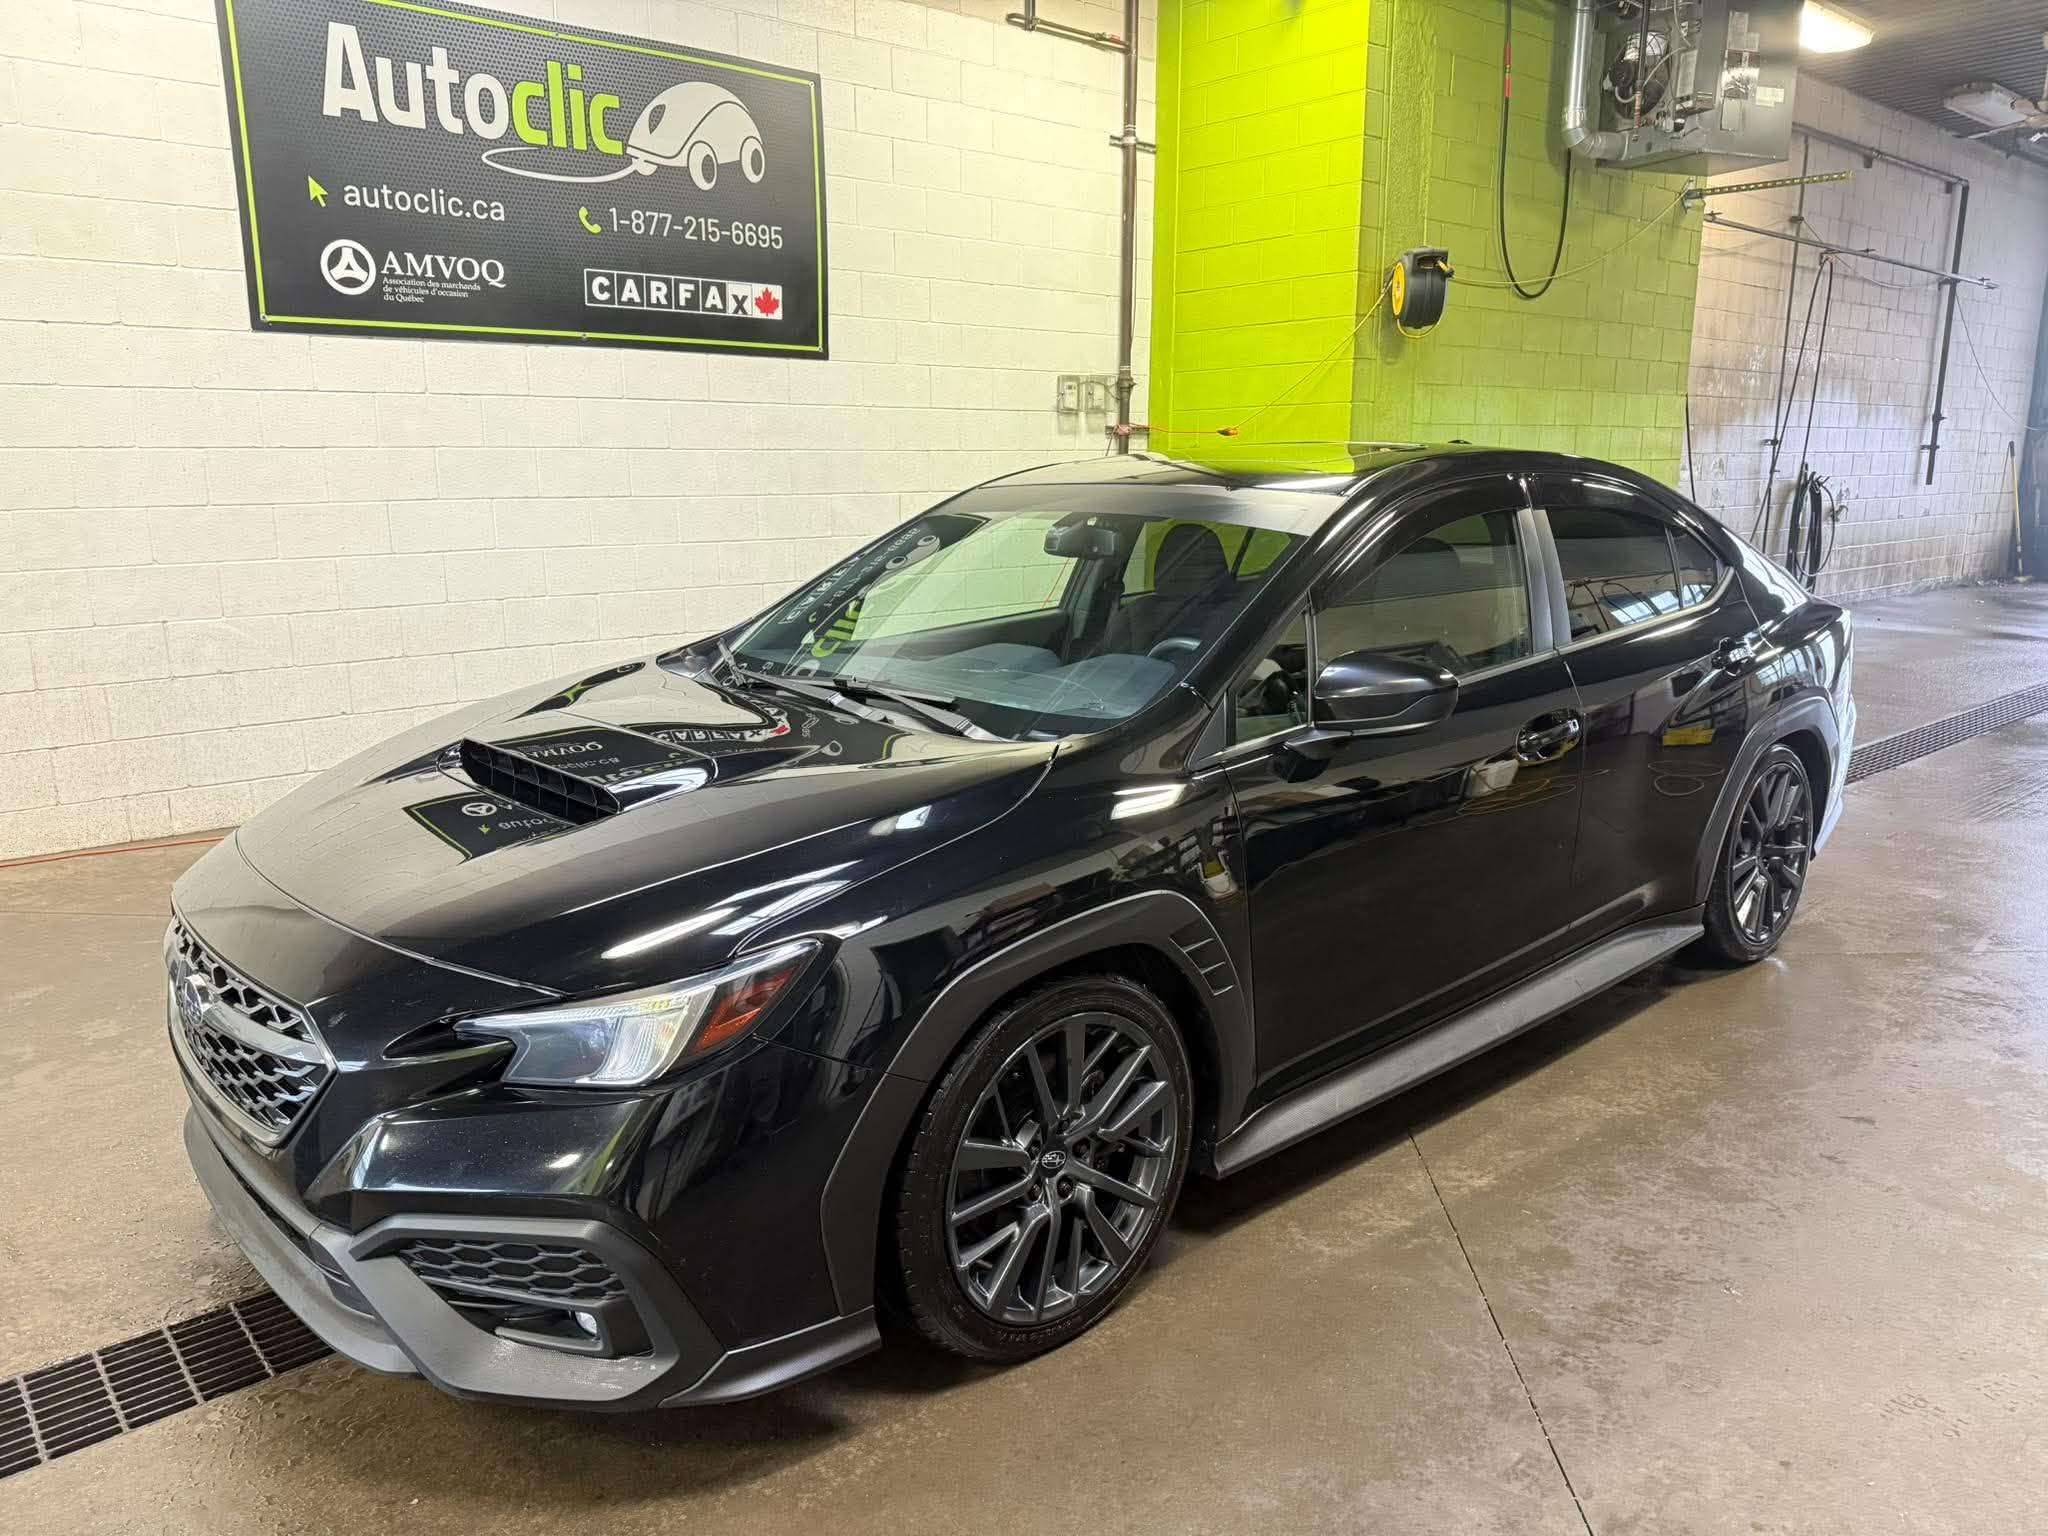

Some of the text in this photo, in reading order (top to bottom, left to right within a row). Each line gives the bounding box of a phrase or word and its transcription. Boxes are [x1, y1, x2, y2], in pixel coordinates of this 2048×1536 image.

[322, 20, 625, 156] Autoclic
[343, 184, 505, 222] autoclic.ca
[609, 207, 783, 250] 1-877-215-6695
[381, 250, 506, 288] AMVOQ
[383, 276, 481, 291] Association des marchands
[382, 284, 469, 298] de véhicules d'occasion
[384, 292, 425, 303] du Québec
[591, 275, 749, 306] CARFAX
